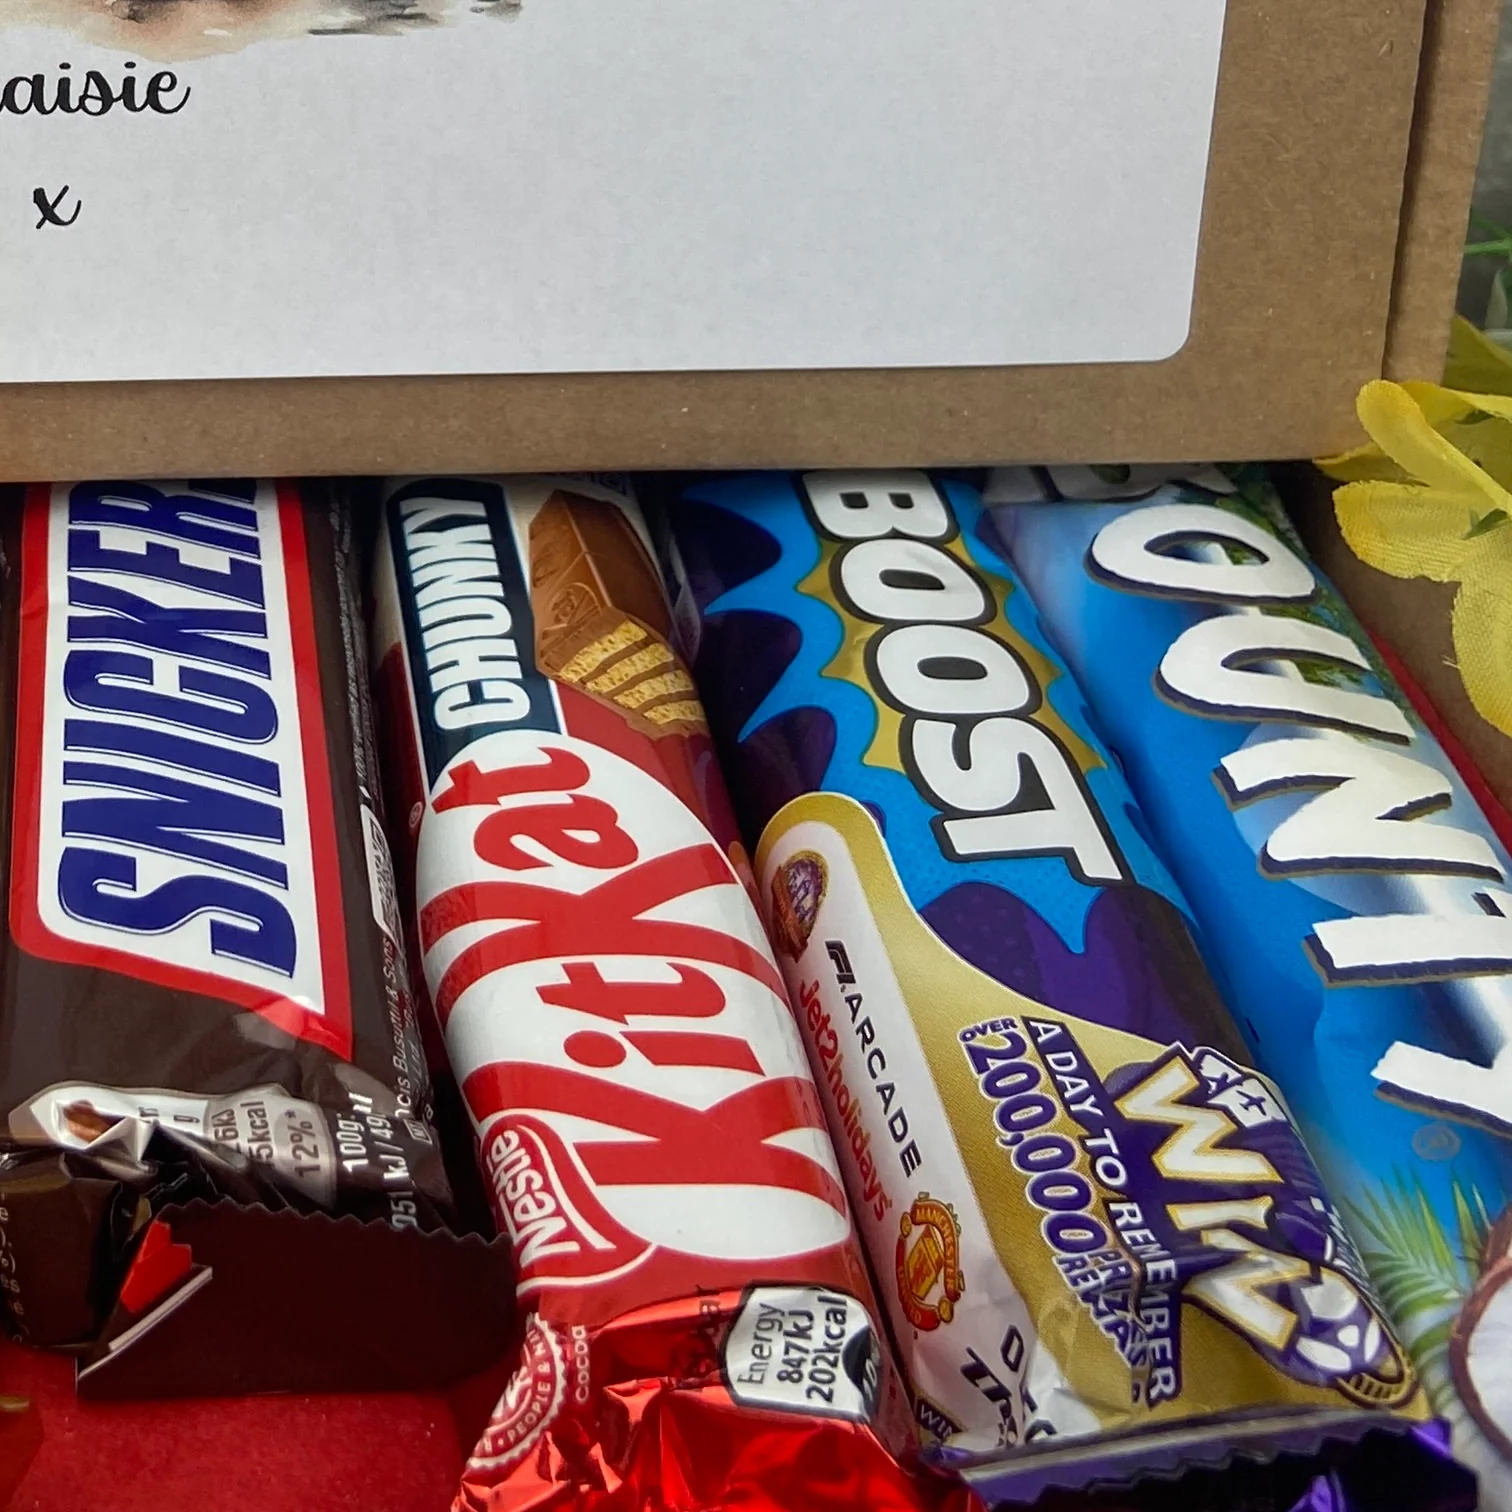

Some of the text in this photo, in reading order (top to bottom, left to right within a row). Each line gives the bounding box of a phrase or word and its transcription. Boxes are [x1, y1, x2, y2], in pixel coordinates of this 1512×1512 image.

[33, 185, 82, 230] x
[399, 496, 531, 730] CHUNKY
[796, 469, 1128, 884] BOOST
[420, 744, 848, 1225] KitKat
[844, 991, 923, 1179] ARCADE
[960, 1017, 1019, 1044] OVER
[965, 1031, 1108, 1254] 200,000
[1029, 1020, 1178, 1401] A DAY TO REMEMBER
[1114, 1054, 1311, 1351] WIN
[736, 1302, 786, 1385] Energy
[776, 1309, 815, 1384] 847kJ
[805, 1295, 848, 1404] 202kcal
